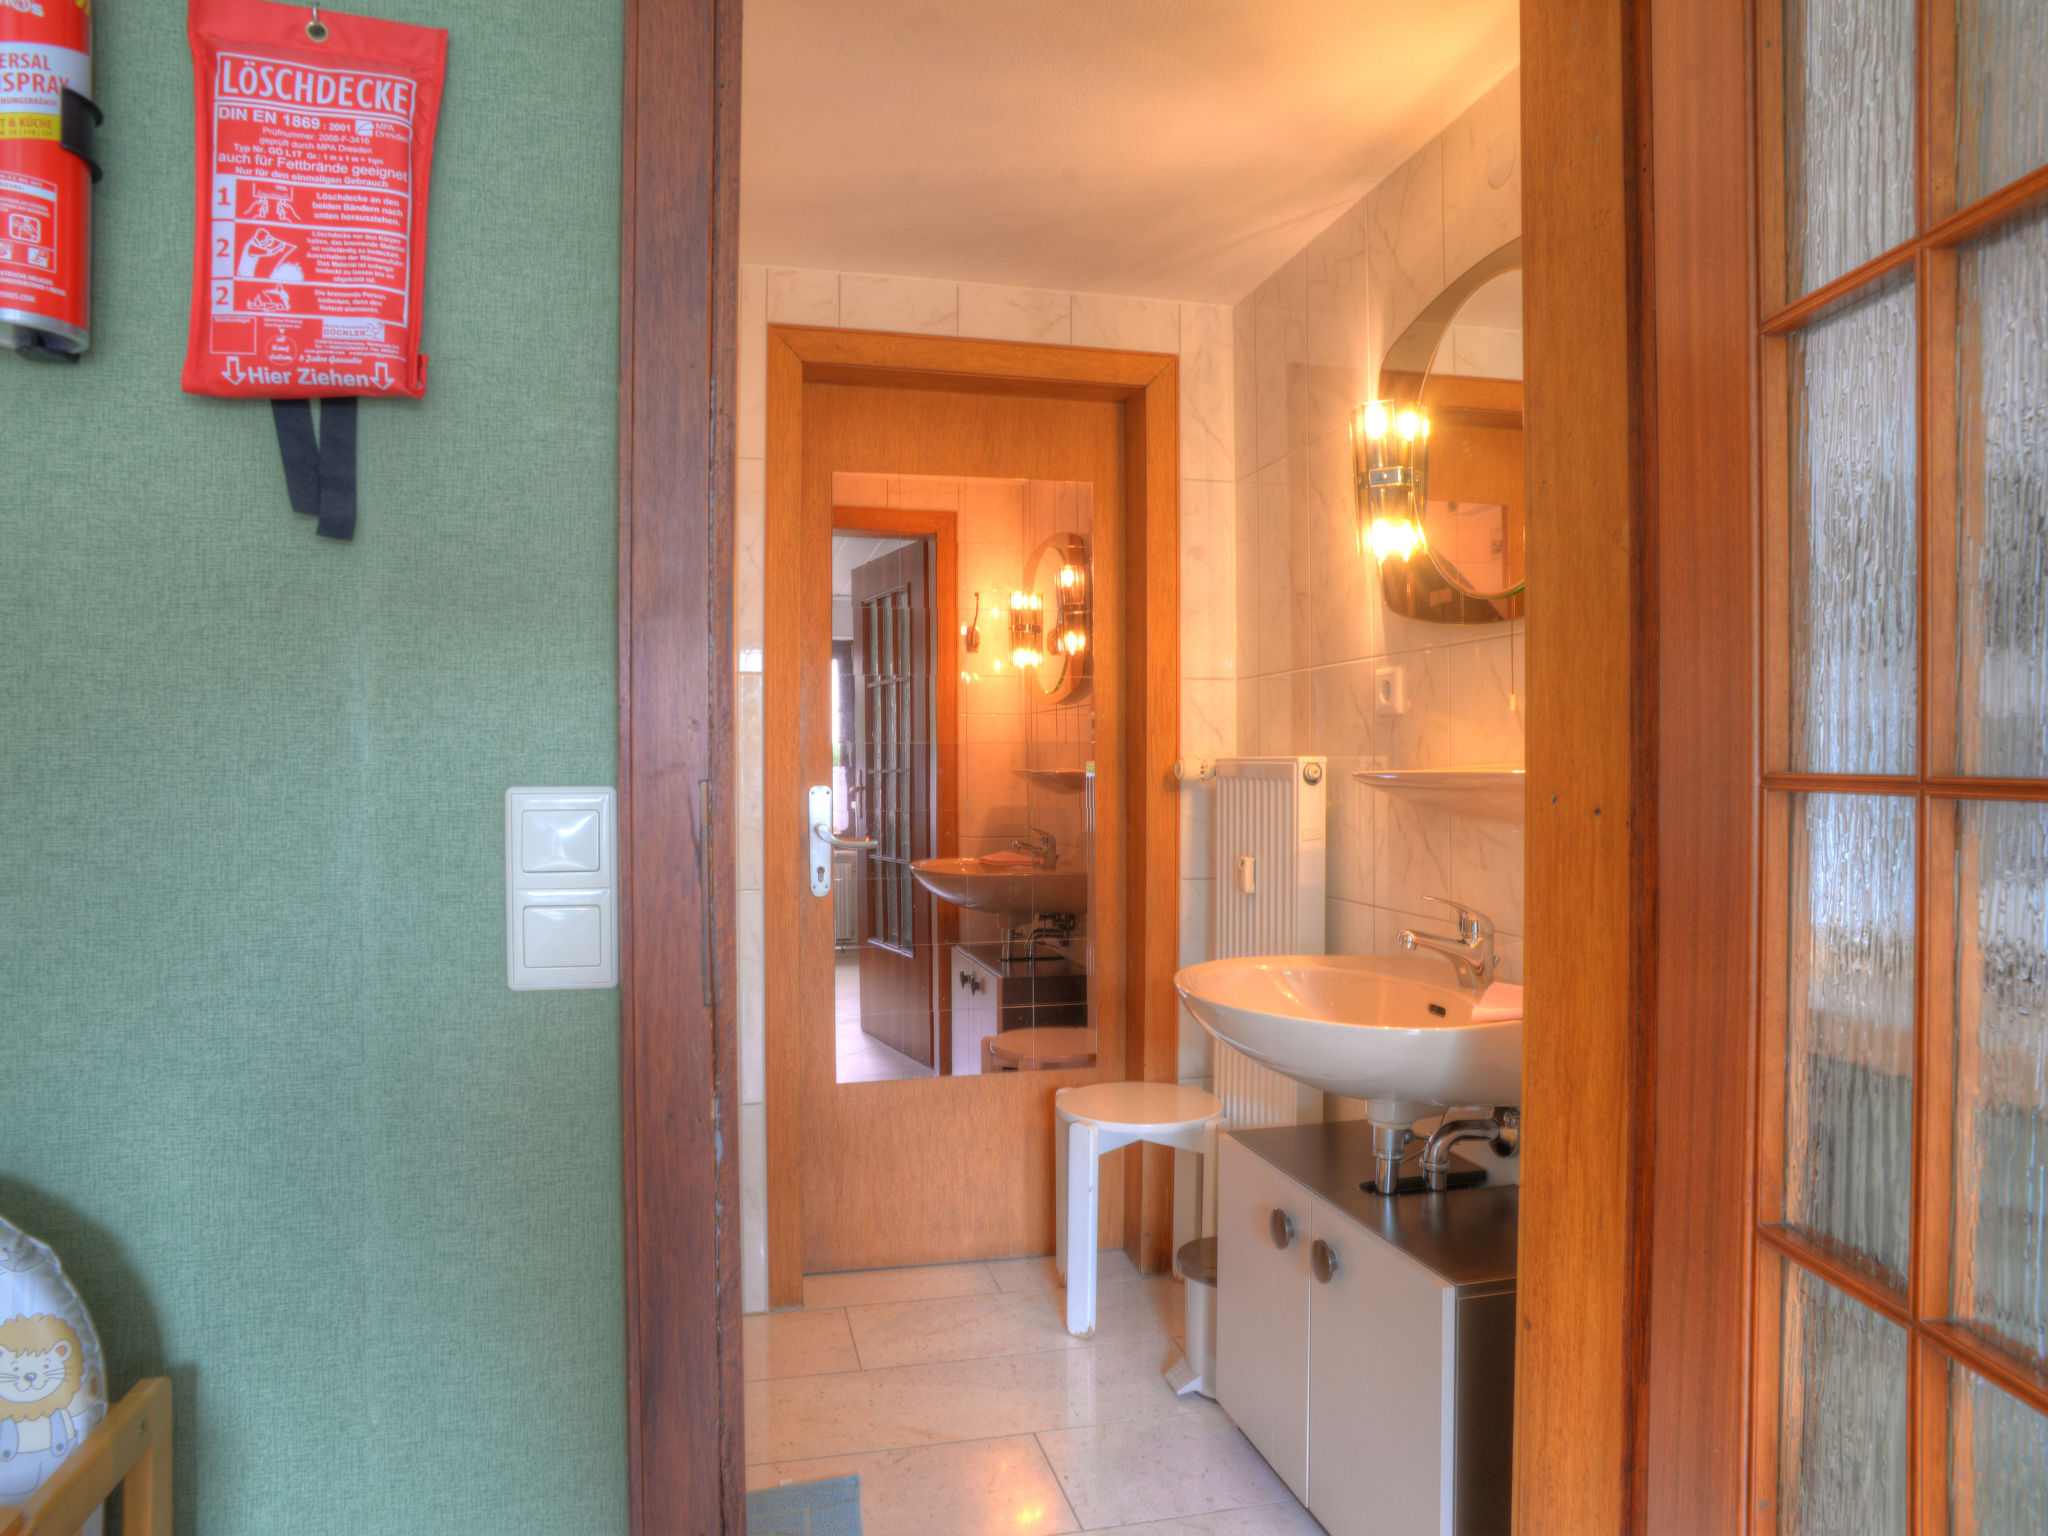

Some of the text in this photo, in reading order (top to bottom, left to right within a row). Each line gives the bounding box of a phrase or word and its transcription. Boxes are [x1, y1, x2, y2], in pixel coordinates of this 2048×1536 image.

[223, 60, 409, 115] LÖSCHDECKE
[219, 106, 247, 121] DIN
[253, 109, 277, 124] EN
[282, 113, 320, 129] 1869
[328, 122, 351, 132] 2001
[375, 122, 394, 131] MPA
[233, 142, 251, 153] Typ
[291, 140, 314, 150] durch
[316, 143, 336, 152] MPA
[338, 144, 373, 155] Dresden
[218, 152, 407, 183] auch für Fettbrände geeignet
[235, 166, 388, 188] Nur für den einmaligen Gebrauch
[217, 186, 231, 205] 1
[316, 192, 399, 206] Löschdecke an den
[312, 202, 403, 217] beiden Bändern nach
[215, 238, 229, 257] 2
[215, 286, 229, 305] 2
[247, 366, 370, 388] Hier Ziehen
